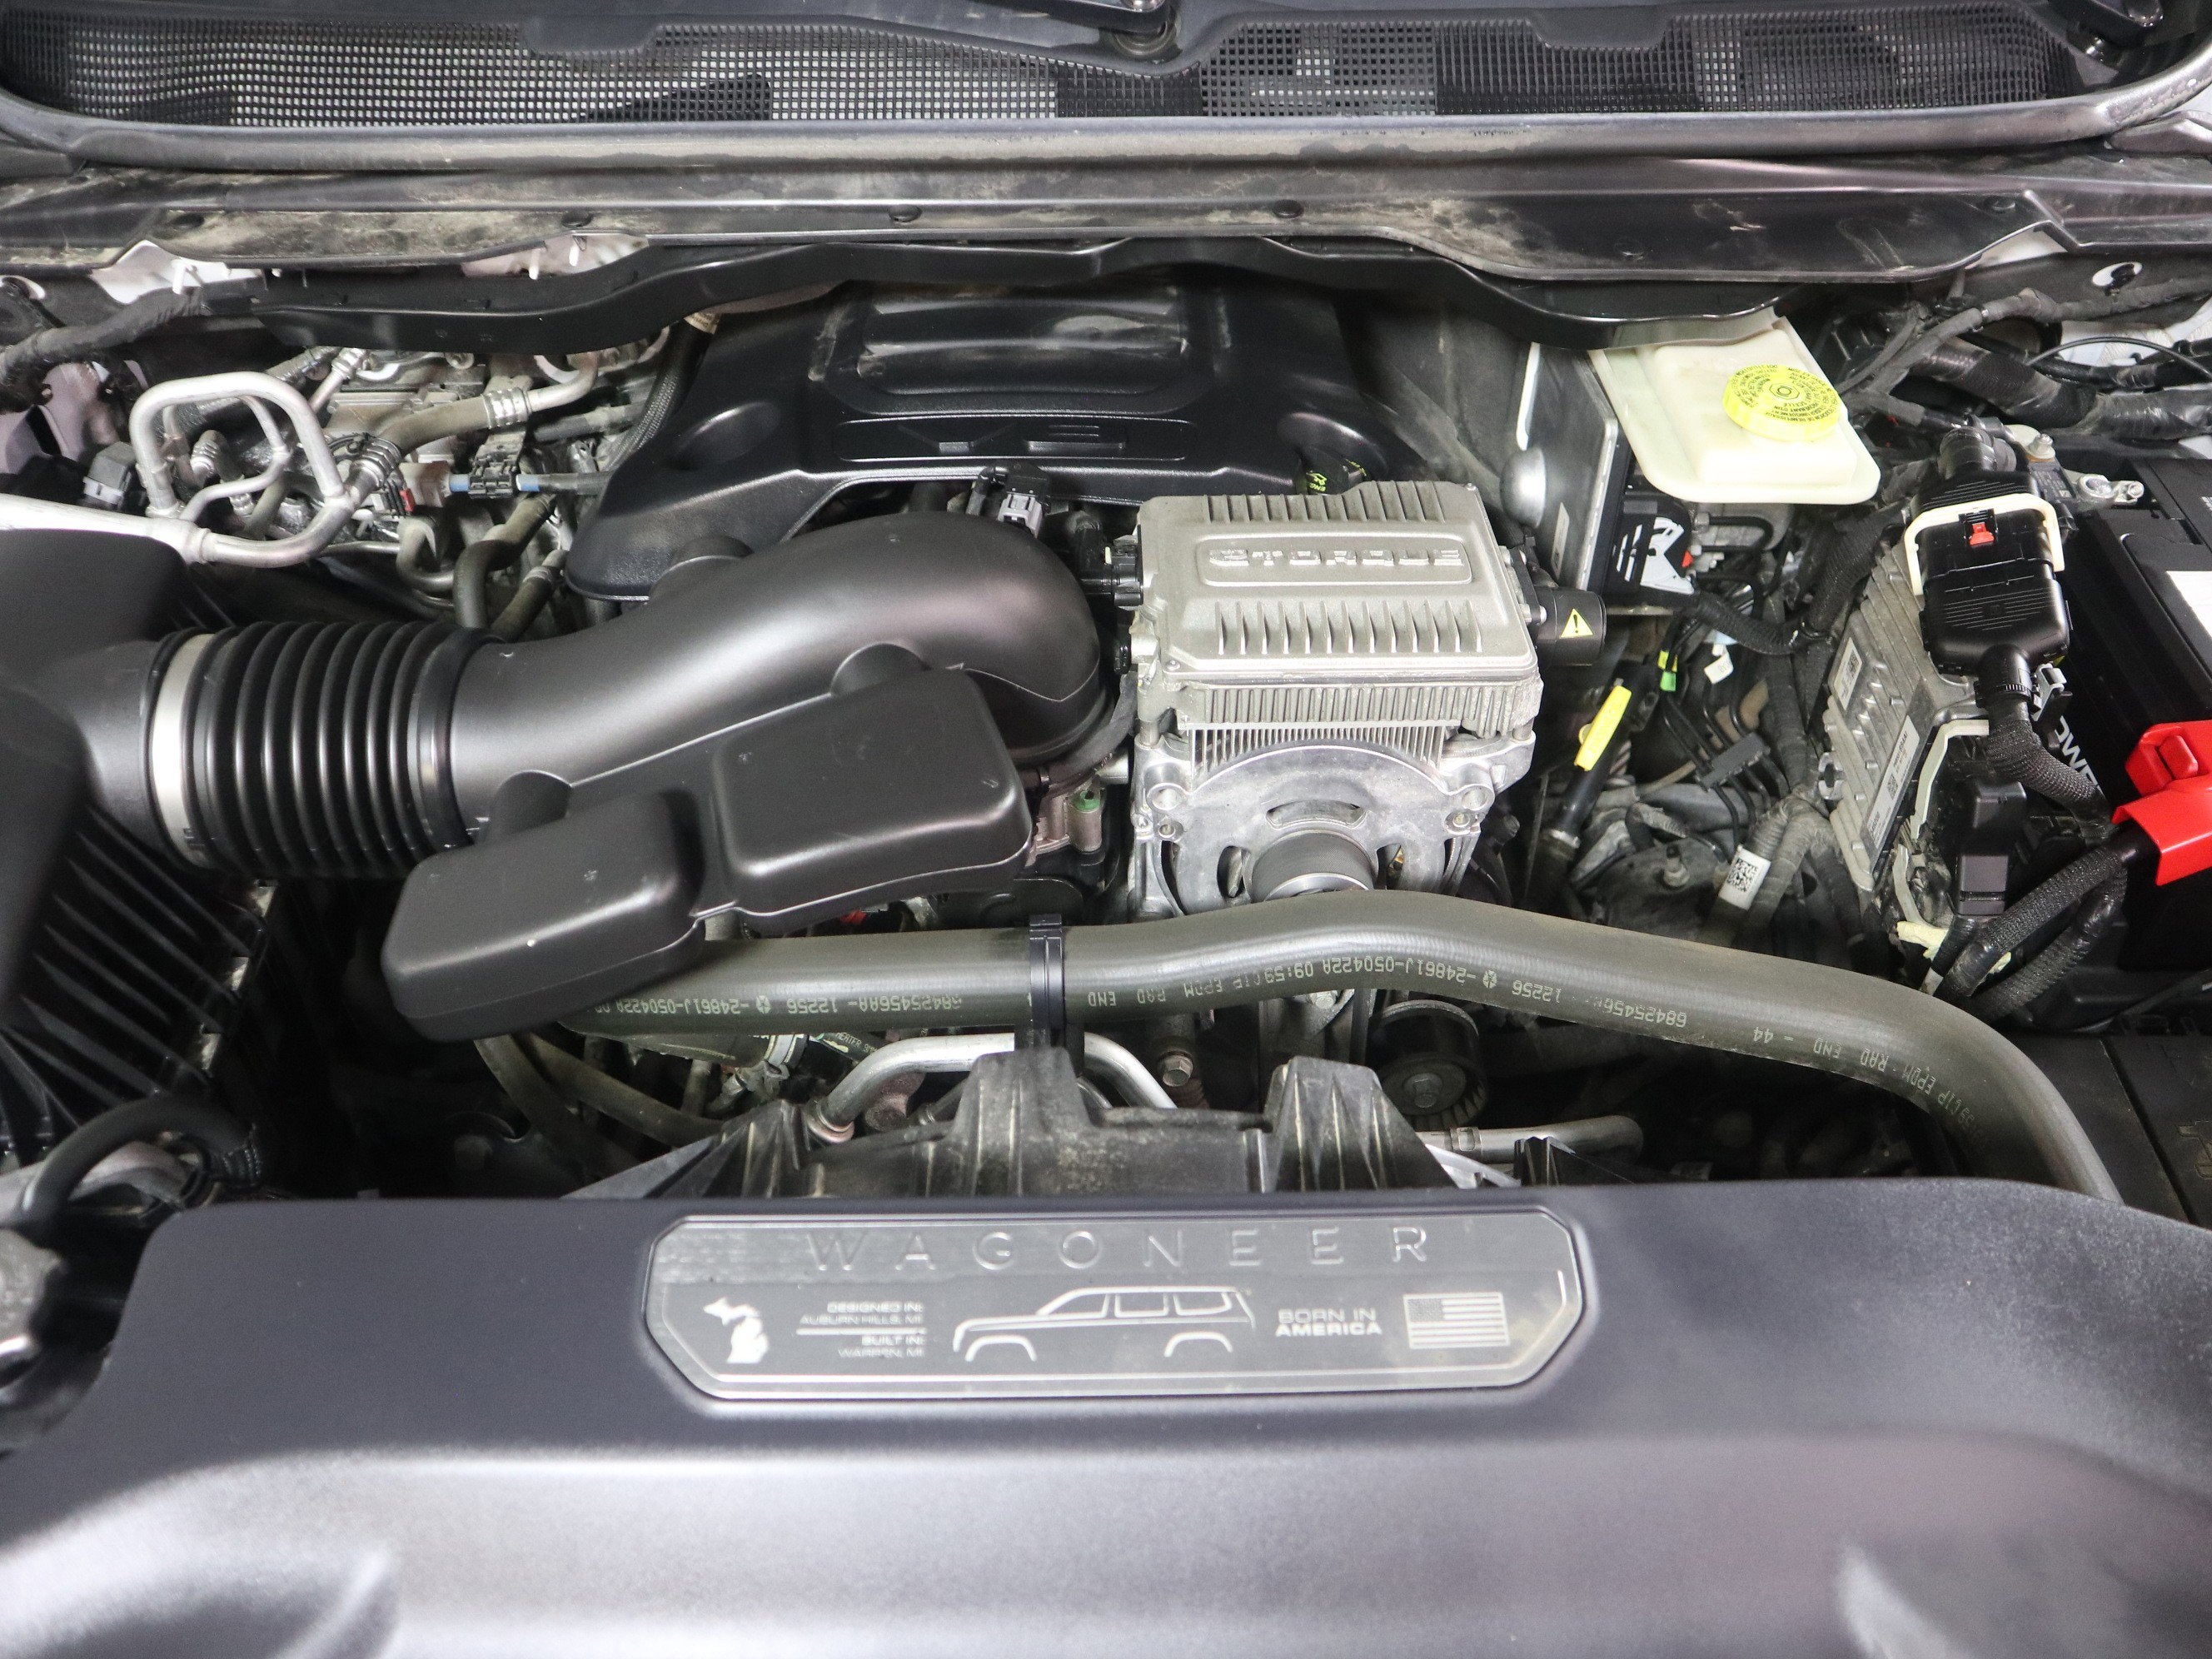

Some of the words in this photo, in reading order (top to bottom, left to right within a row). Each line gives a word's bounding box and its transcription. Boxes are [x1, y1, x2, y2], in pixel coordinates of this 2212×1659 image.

[1088, 991, 1117, 1007] END
[1512, 979, 1562, 1003] 12256
[786, 997, 838, 1014] 12256
[1752, 1026, 1774, 1044] 44
[806, 1226, 1427, 1271] WAGONEER
[827, 1301, 901, 1313] DESIGNED
[1278, 1308, 1345, 1323] BORN
[1353, 1308, 1376, 1323] IN
[1275, 1322, 1382, 1337] AMERICA
